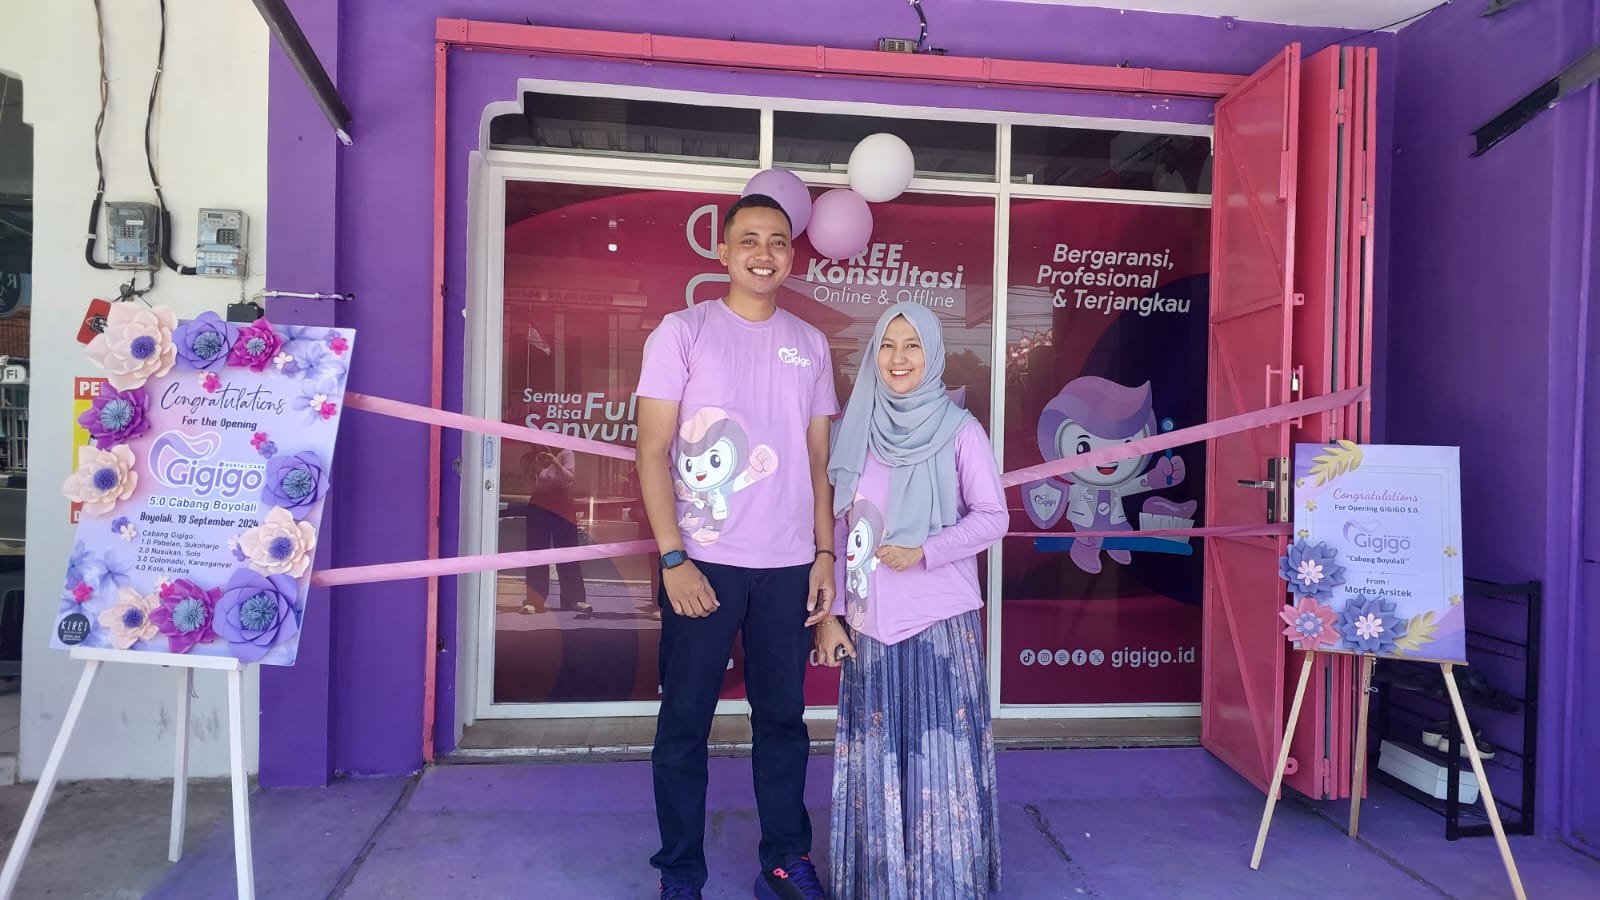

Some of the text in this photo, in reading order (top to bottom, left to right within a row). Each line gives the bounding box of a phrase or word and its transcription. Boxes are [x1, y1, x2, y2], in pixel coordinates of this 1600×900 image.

[832, 243, 904, 268] REE
[1053, 243, 1174, 270] Bergaransi,
[806, 258, 964, 289] Konsultasi
[1037, 264, 1158, 288] Profesional
[814, 286, 954, 308] Online & Offline
[1052, 288, 1190, 317] & Terjangkau
[160, 382, 286, 414] Congratulations
[522, 388, 582, 404] Semua
[546, 404, 582, 420] Bisa
[584, 392, 637, 421] Ful
[182, 416, 258, 432] For the Opening
[166, 458, 263, 497] Gigigo
[149, 496, 257, 513] 5.0 Cabang Boyolali
[1333, 488, 1418, 502] Congratulations
[1348, 504, 1378, 513] Opening
[178, 514, 187, 524] 19
[189, 516, 235, 528] September
[238, 518, 259, 528] 2024
[142, 530, 168, 538] Cabang
[1354, 532, 1411, 554] Gigigo
[184, 542, 220, 551] Sukoharjo
[188, 560, 232, 569] Karanganyar
[1344, 586, 1412, 598] Morfes Arsitek
[1111, 646, 1196, 668] gigigo.id
